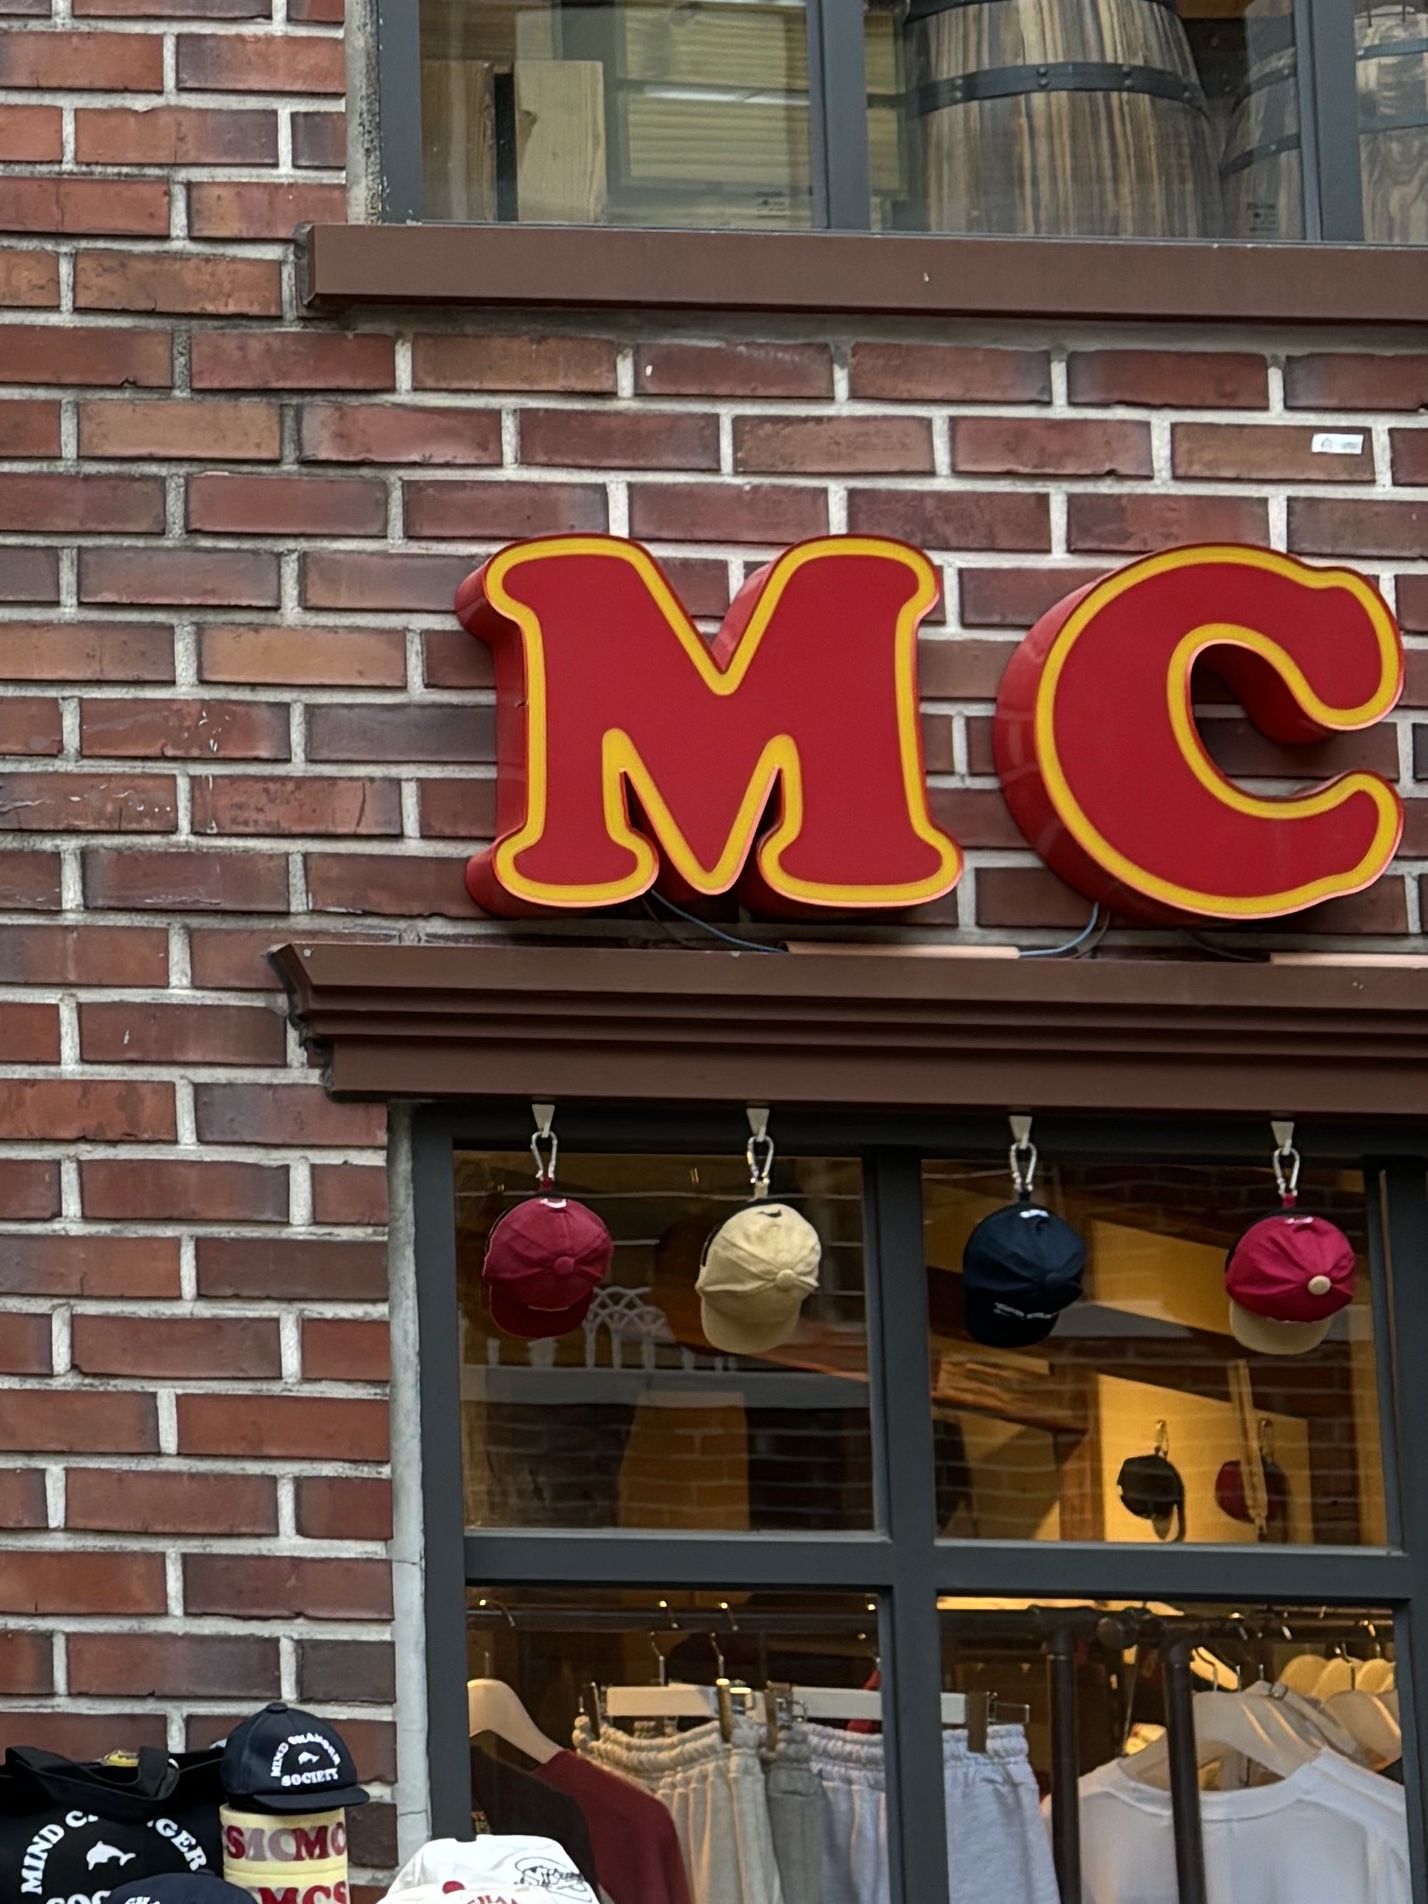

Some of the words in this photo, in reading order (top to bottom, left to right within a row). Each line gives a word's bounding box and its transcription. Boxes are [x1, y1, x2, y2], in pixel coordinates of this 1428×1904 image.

[457, 532, 1405, 922] MC
[280, 1767, 340, 1787] SOCIETY
[20, 1823, 65, 1895] MIND
